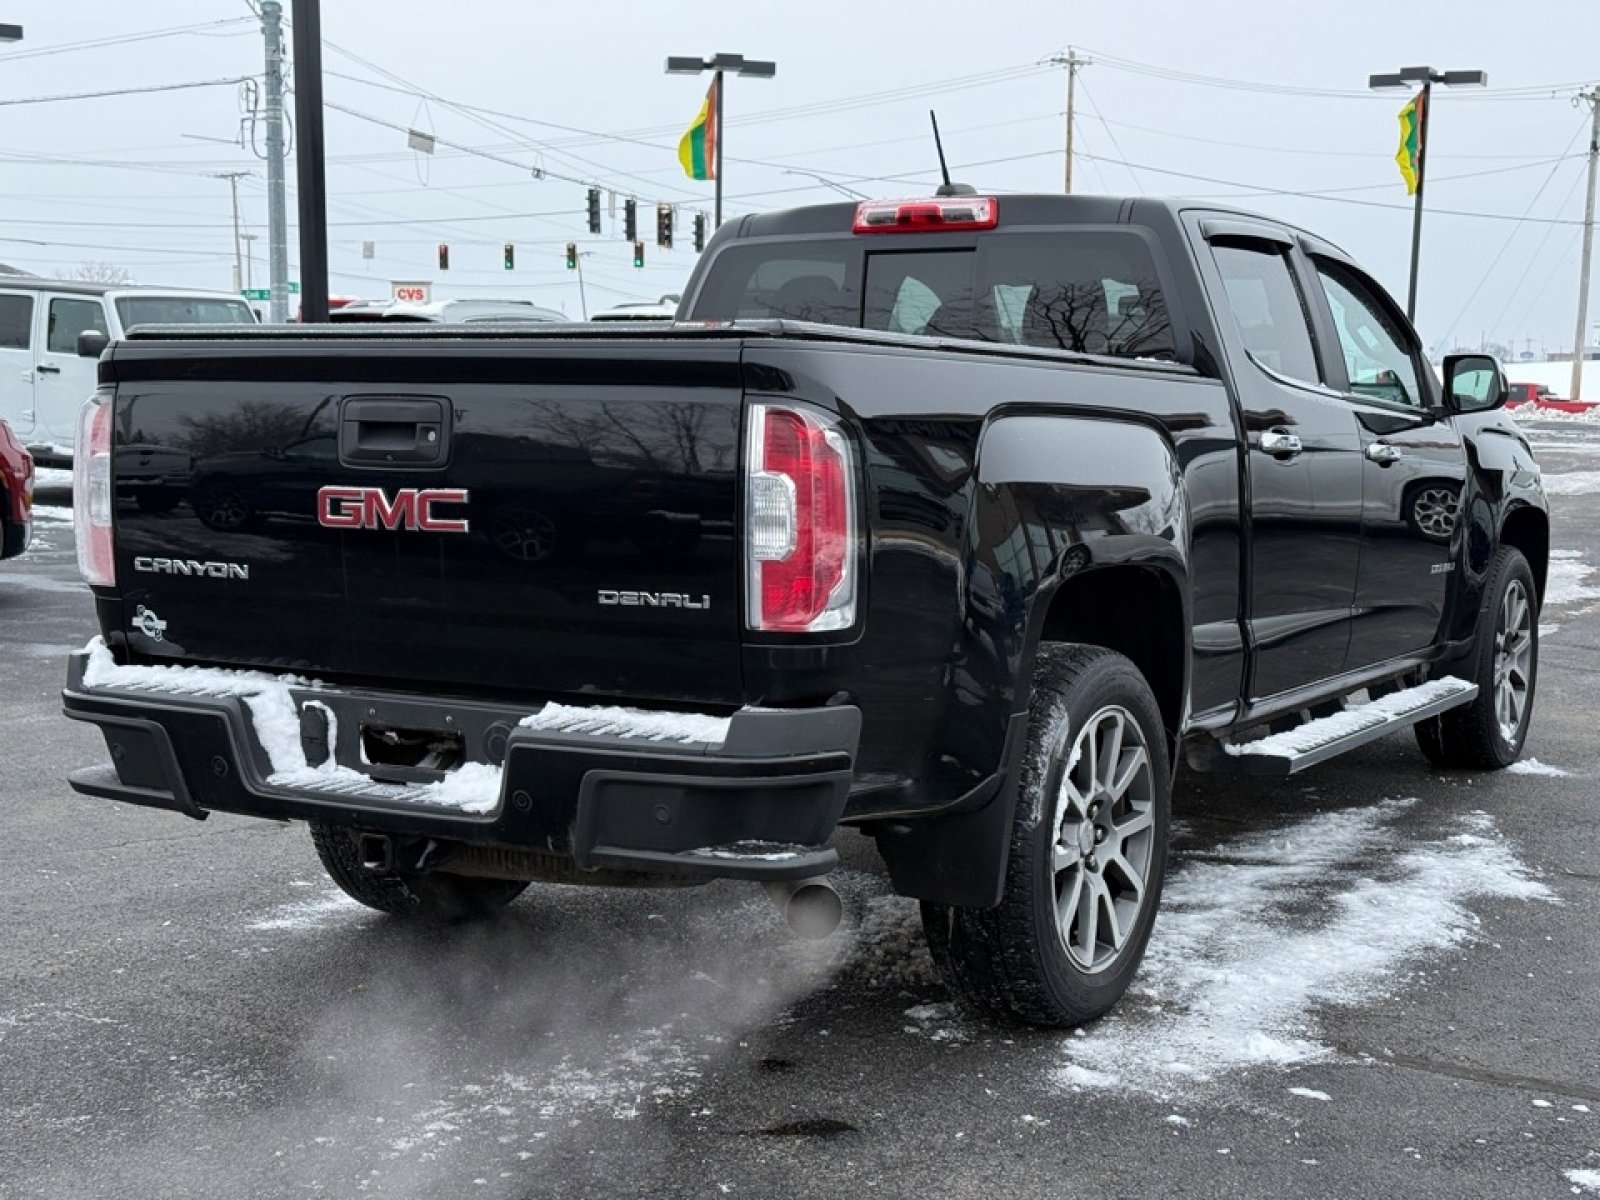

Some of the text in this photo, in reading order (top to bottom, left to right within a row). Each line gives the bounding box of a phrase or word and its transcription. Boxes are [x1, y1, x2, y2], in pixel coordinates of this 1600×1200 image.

[397, 288, 424, 301] CVS
[318, 485, 469, 533] GMC
[134, 556, 249, 579] CANYON
[598, 589, 710, 609] DENALI
